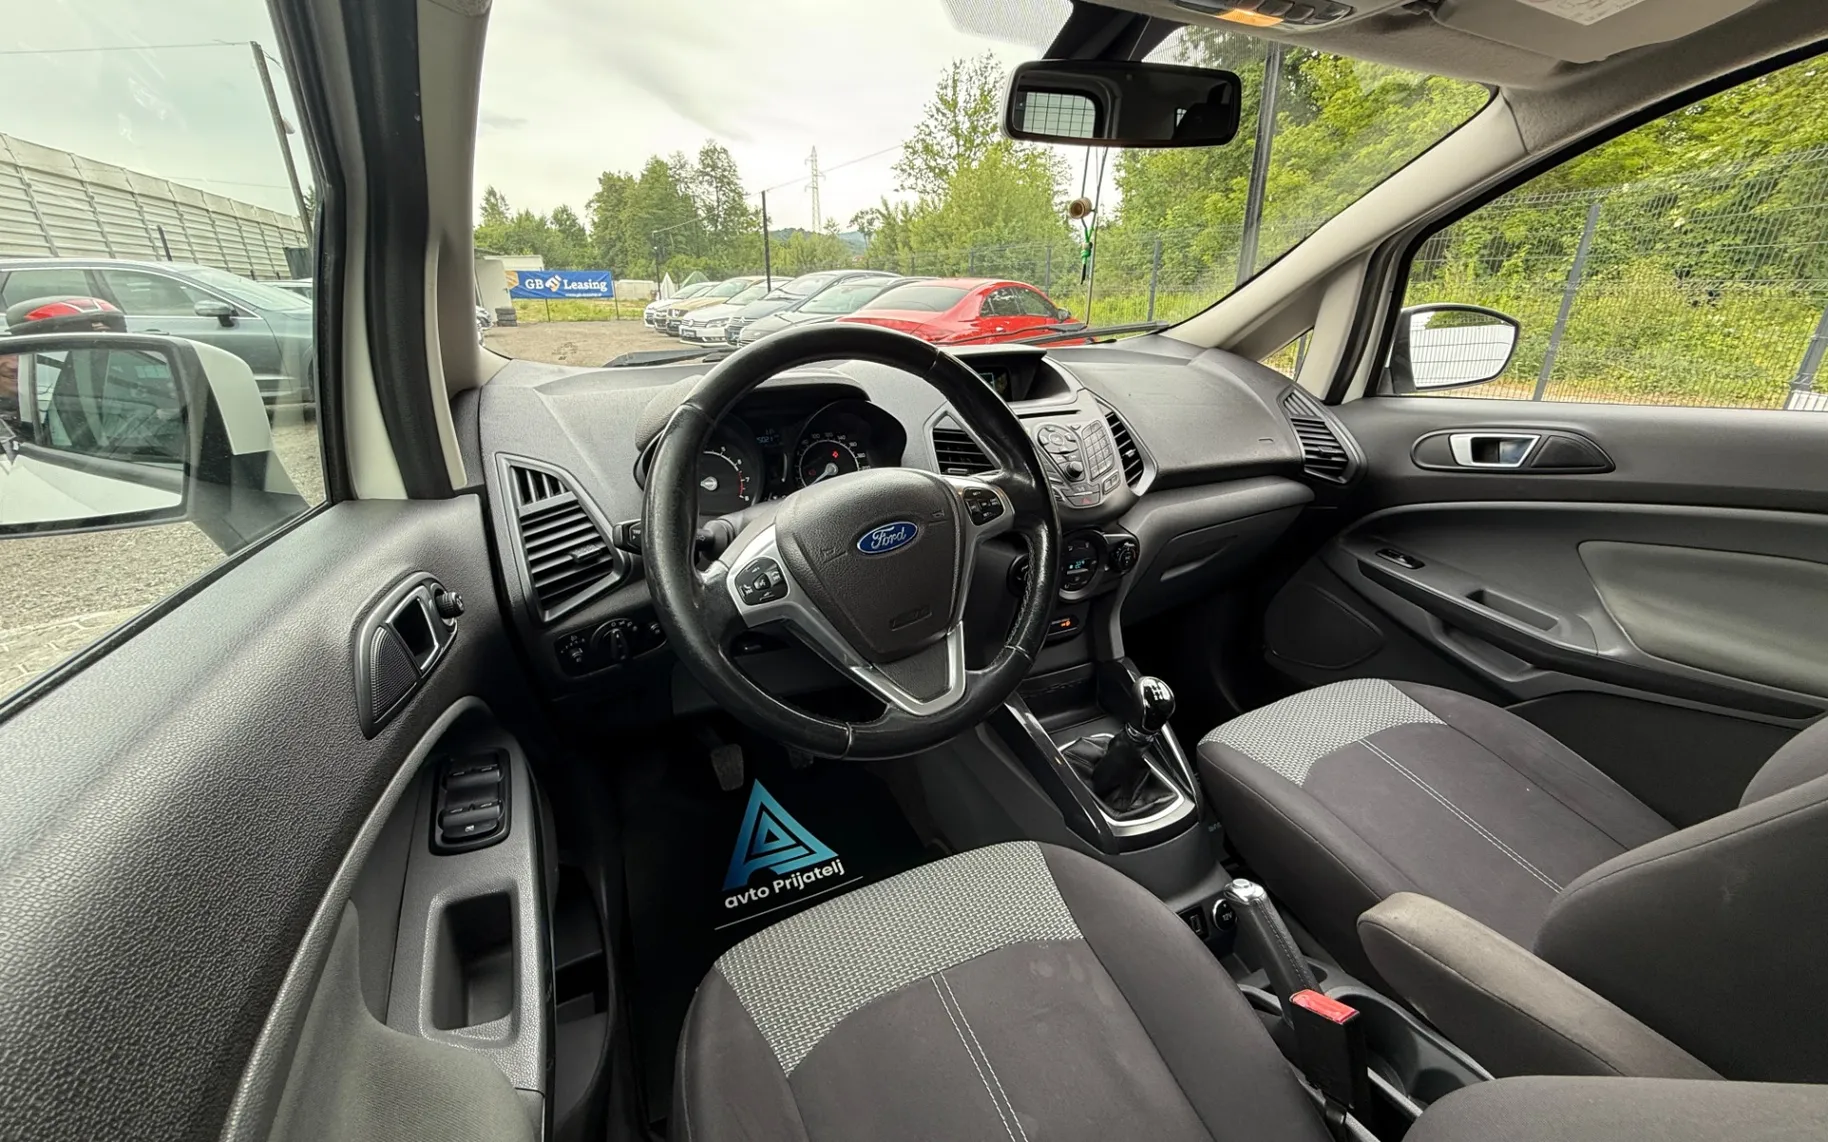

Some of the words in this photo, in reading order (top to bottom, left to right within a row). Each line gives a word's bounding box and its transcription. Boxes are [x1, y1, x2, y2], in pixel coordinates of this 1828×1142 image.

[525, 278, 544, 290] GB
[563, 279, 608, 292] Leasing
[871, 526, 907, 550] Ford
[724, 885, 770, 909] avto
[772, 859, 845, 894] Prijatelj
